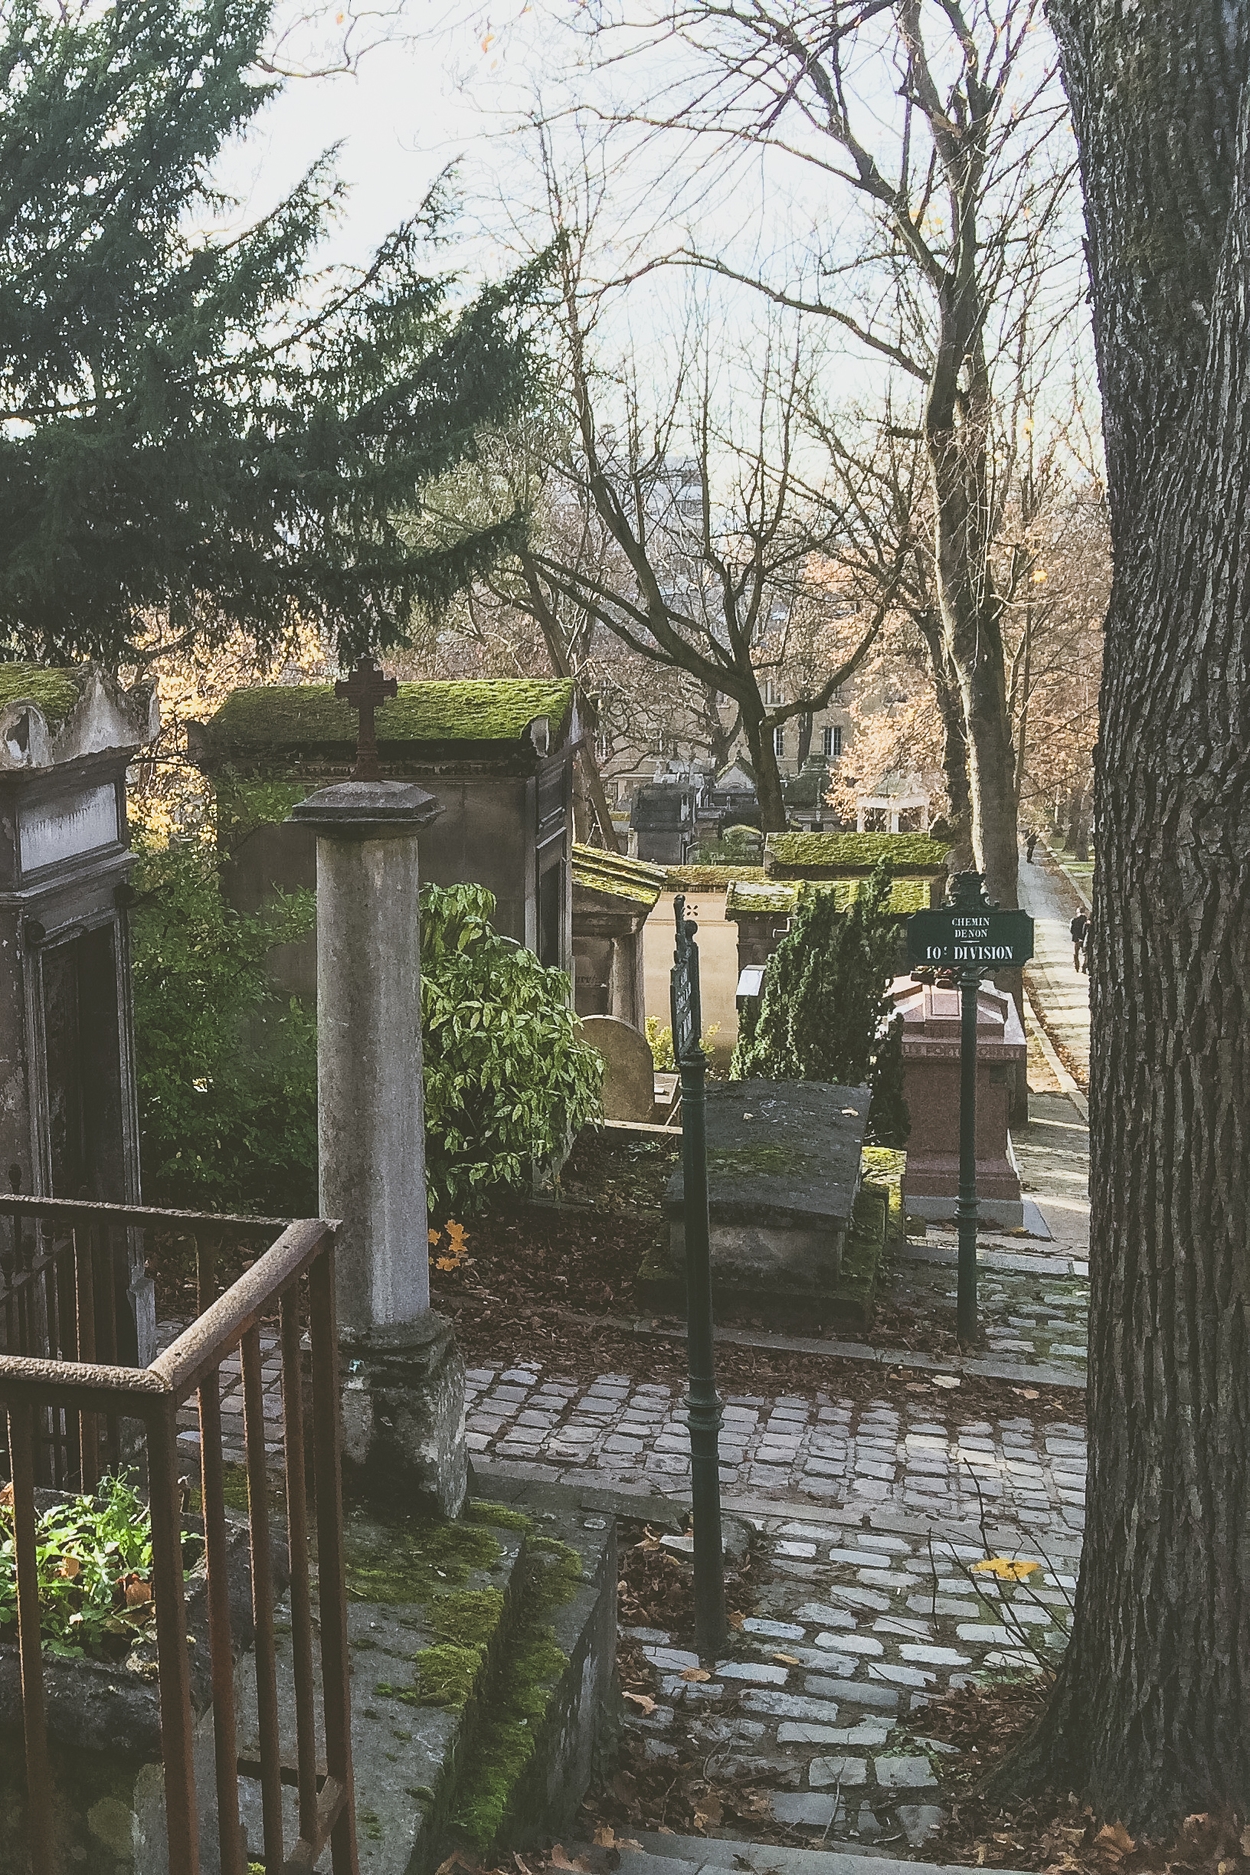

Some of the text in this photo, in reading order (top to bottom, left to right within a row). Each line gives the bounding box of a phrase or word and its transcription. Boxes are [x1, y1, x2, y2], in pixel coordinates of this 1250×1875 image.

[951, 917, 990, 927] CHEMIN
[954, 929, 988, 938] DENON
[954, 946, 1014, 960] DIVISION
